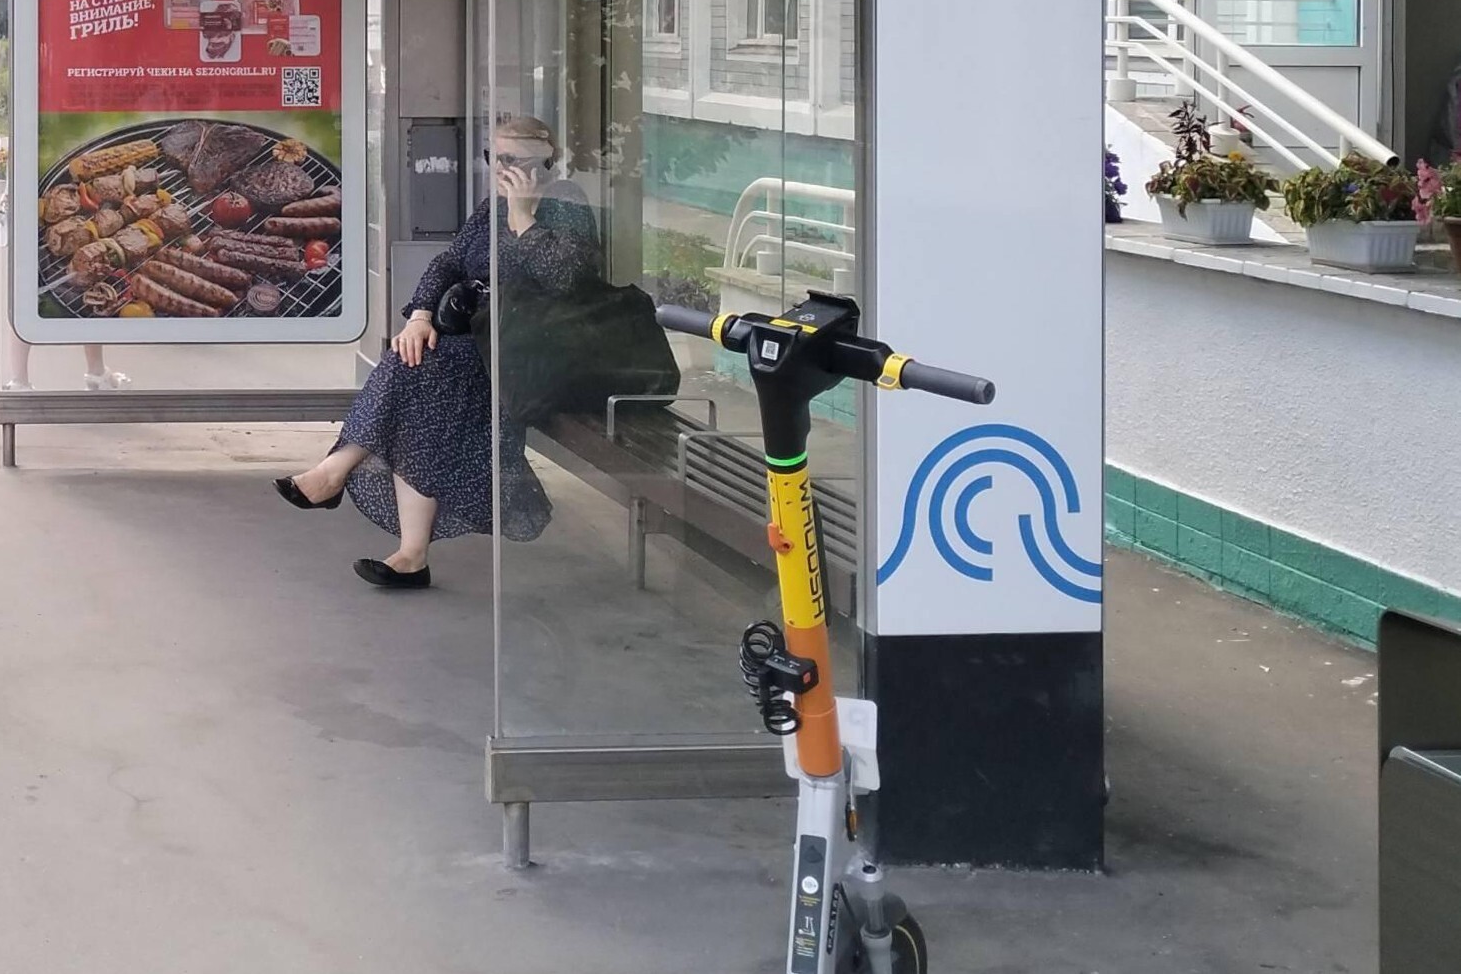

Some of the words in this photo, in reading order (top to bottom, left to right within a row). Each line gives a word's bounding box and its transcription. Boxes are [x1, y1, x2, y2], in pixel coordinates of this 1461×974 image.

[69, 12, 139, 40] ГРИЛЬ!
[67, 66, 145, 77] РЕГИСТРИРУЙ
[147, 67, 177, 76] ЧЕКИ
[179, 67, 193, 76] НА
[195, 67, 276, 76] SEZONGRILL.RU
[799, 478, 824, 620] WHOOSH
